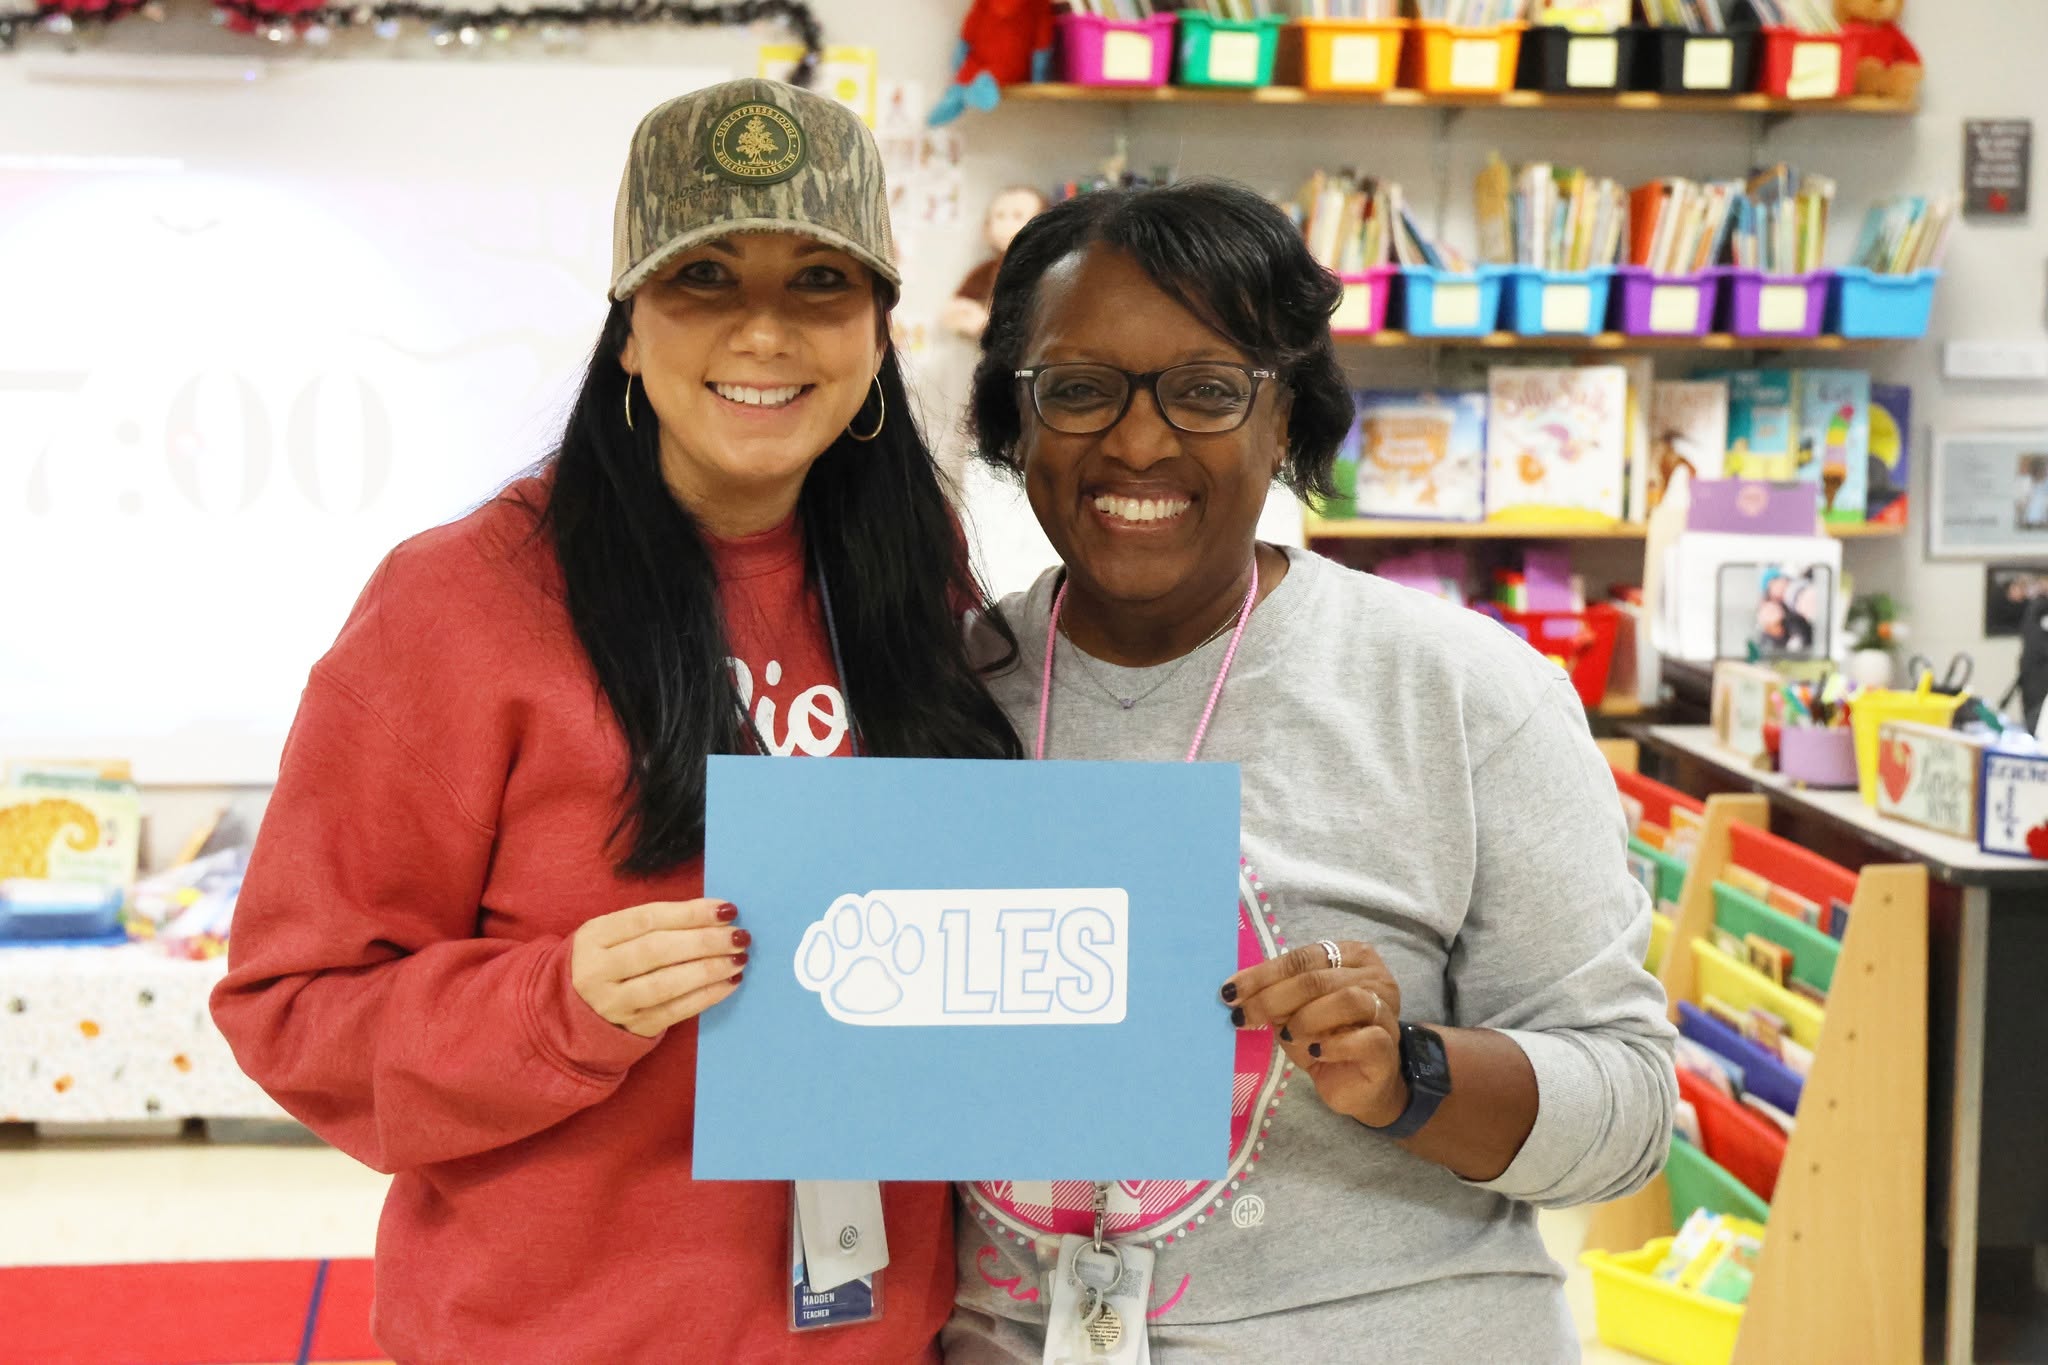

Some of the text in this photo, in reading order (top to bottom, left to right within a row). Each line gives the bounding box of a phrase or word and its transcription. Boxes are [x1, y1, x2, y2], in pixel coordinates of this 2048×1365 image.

[717, 106, 797, 139] OLD CYPRESS LODGE
[716, 151, 757, 175] REELFOOT
[786, 152, 796, 164] TN
[938, 906, 1116, 1014] LES
[802, 1292, 835, 1306] MADDEN
[802, 1308, 830, 1320] TEACHER
